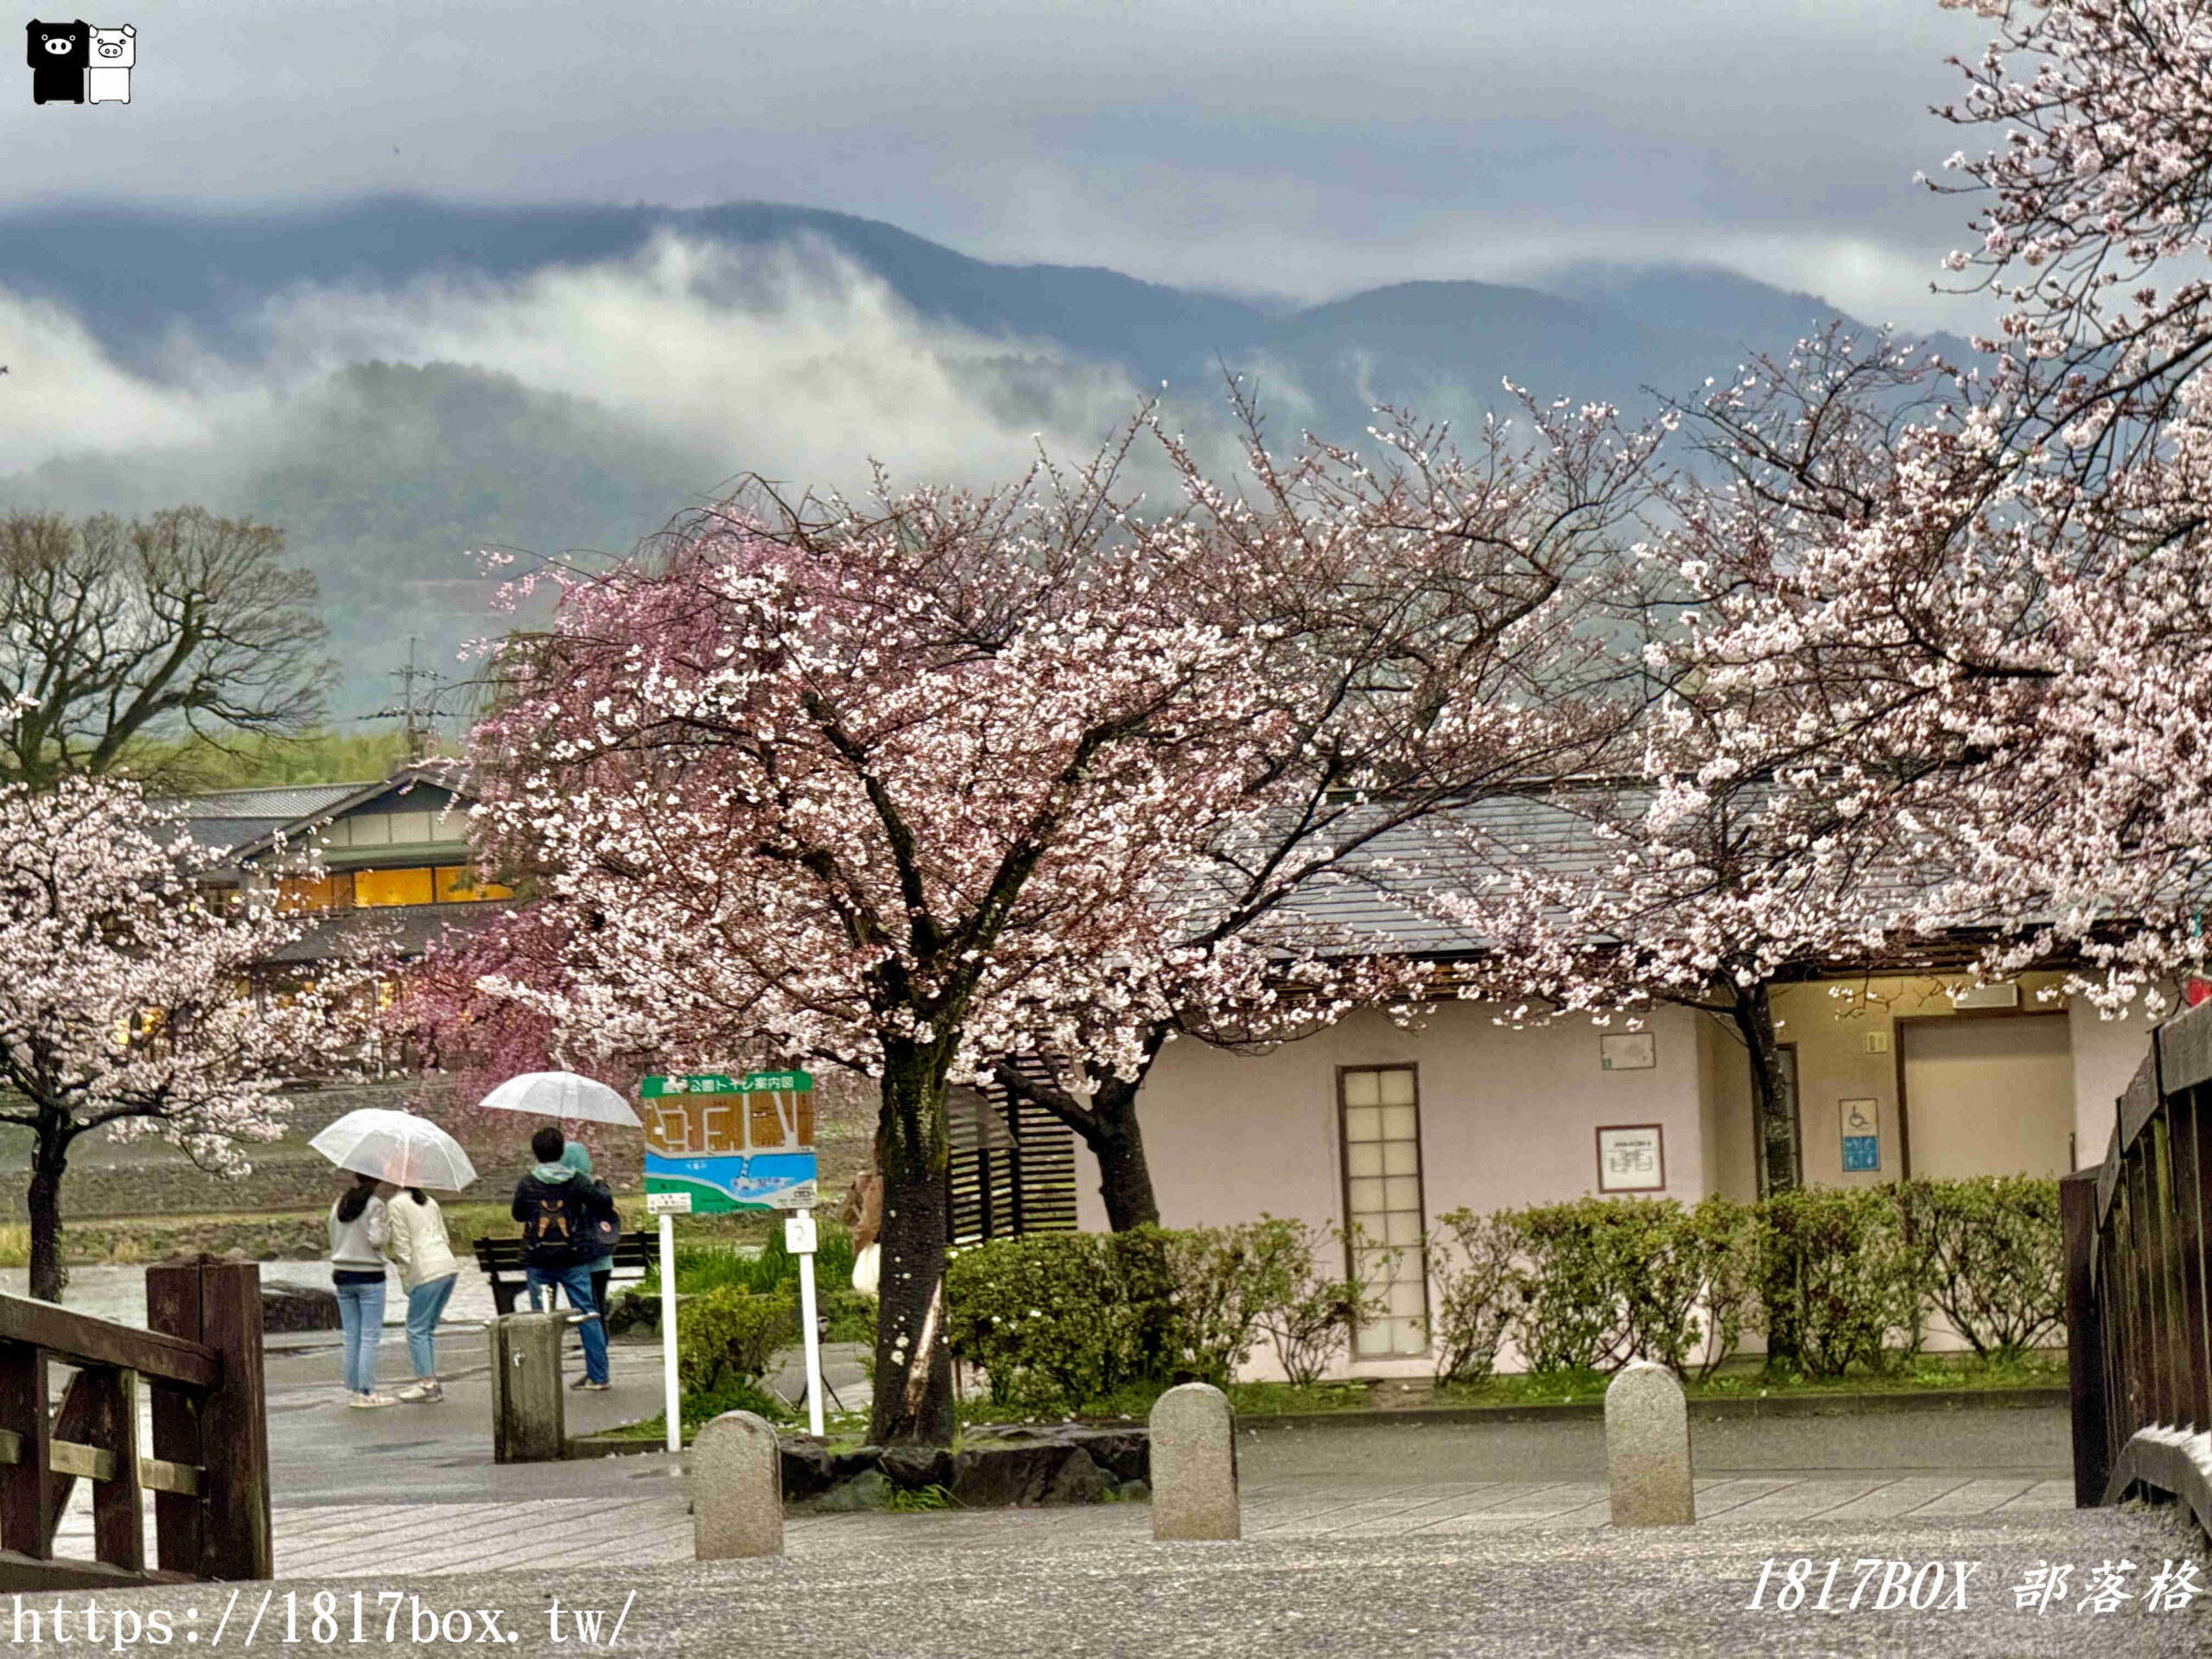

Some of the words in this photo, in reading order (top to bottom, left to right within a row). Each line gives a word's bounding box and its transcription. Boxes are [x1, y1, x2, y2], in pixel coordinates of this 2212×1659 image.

[662, 1076, 794, 1094] 公園トイレ案内図
